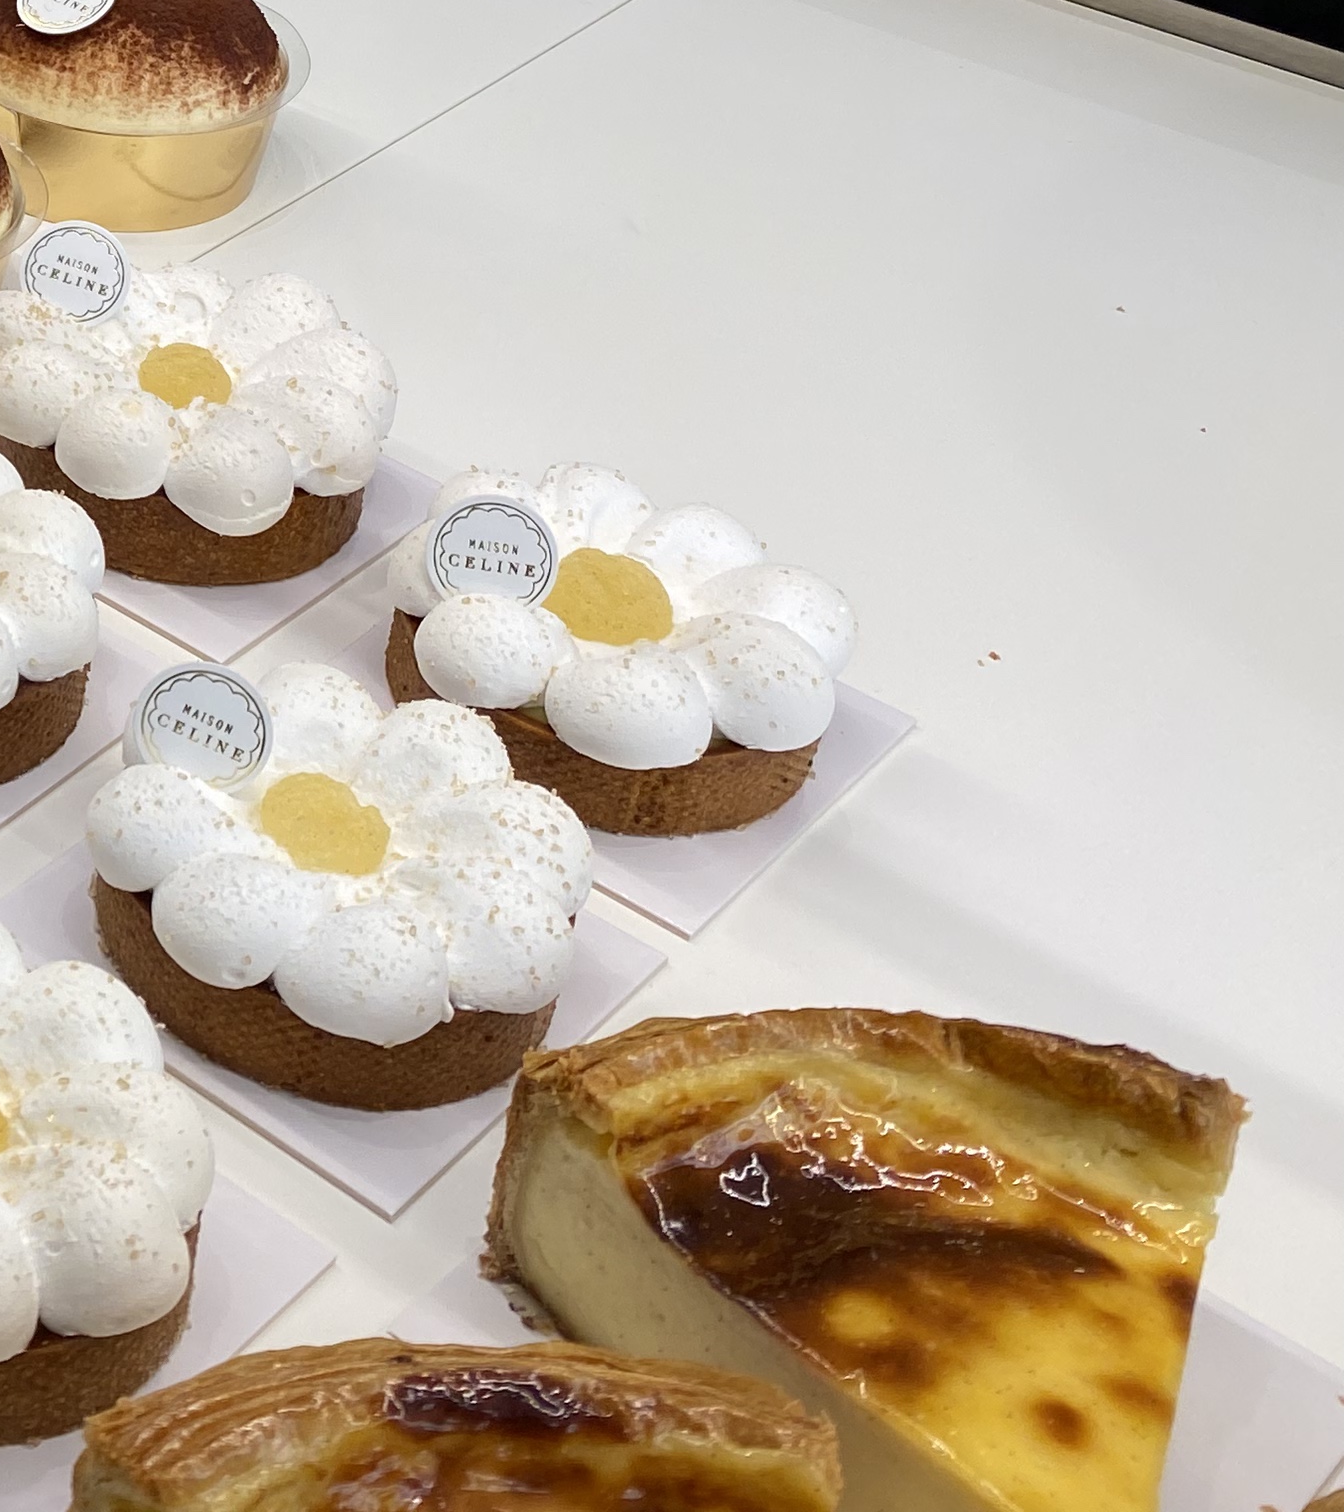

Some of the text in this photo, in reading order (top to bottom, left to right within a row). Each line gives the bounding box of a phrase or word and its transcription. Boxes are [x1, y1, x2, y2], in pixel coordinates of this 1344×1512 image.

[57, 254, 99, 276] MAISON
[37, 264, 109, 297] CELINE
[468, 539, 520, 556] MAISON
[448, 553, 536, 578] CELINE
[182, 703, 235, 735] MAISON
[157, 713, 245, 763] CELINE
